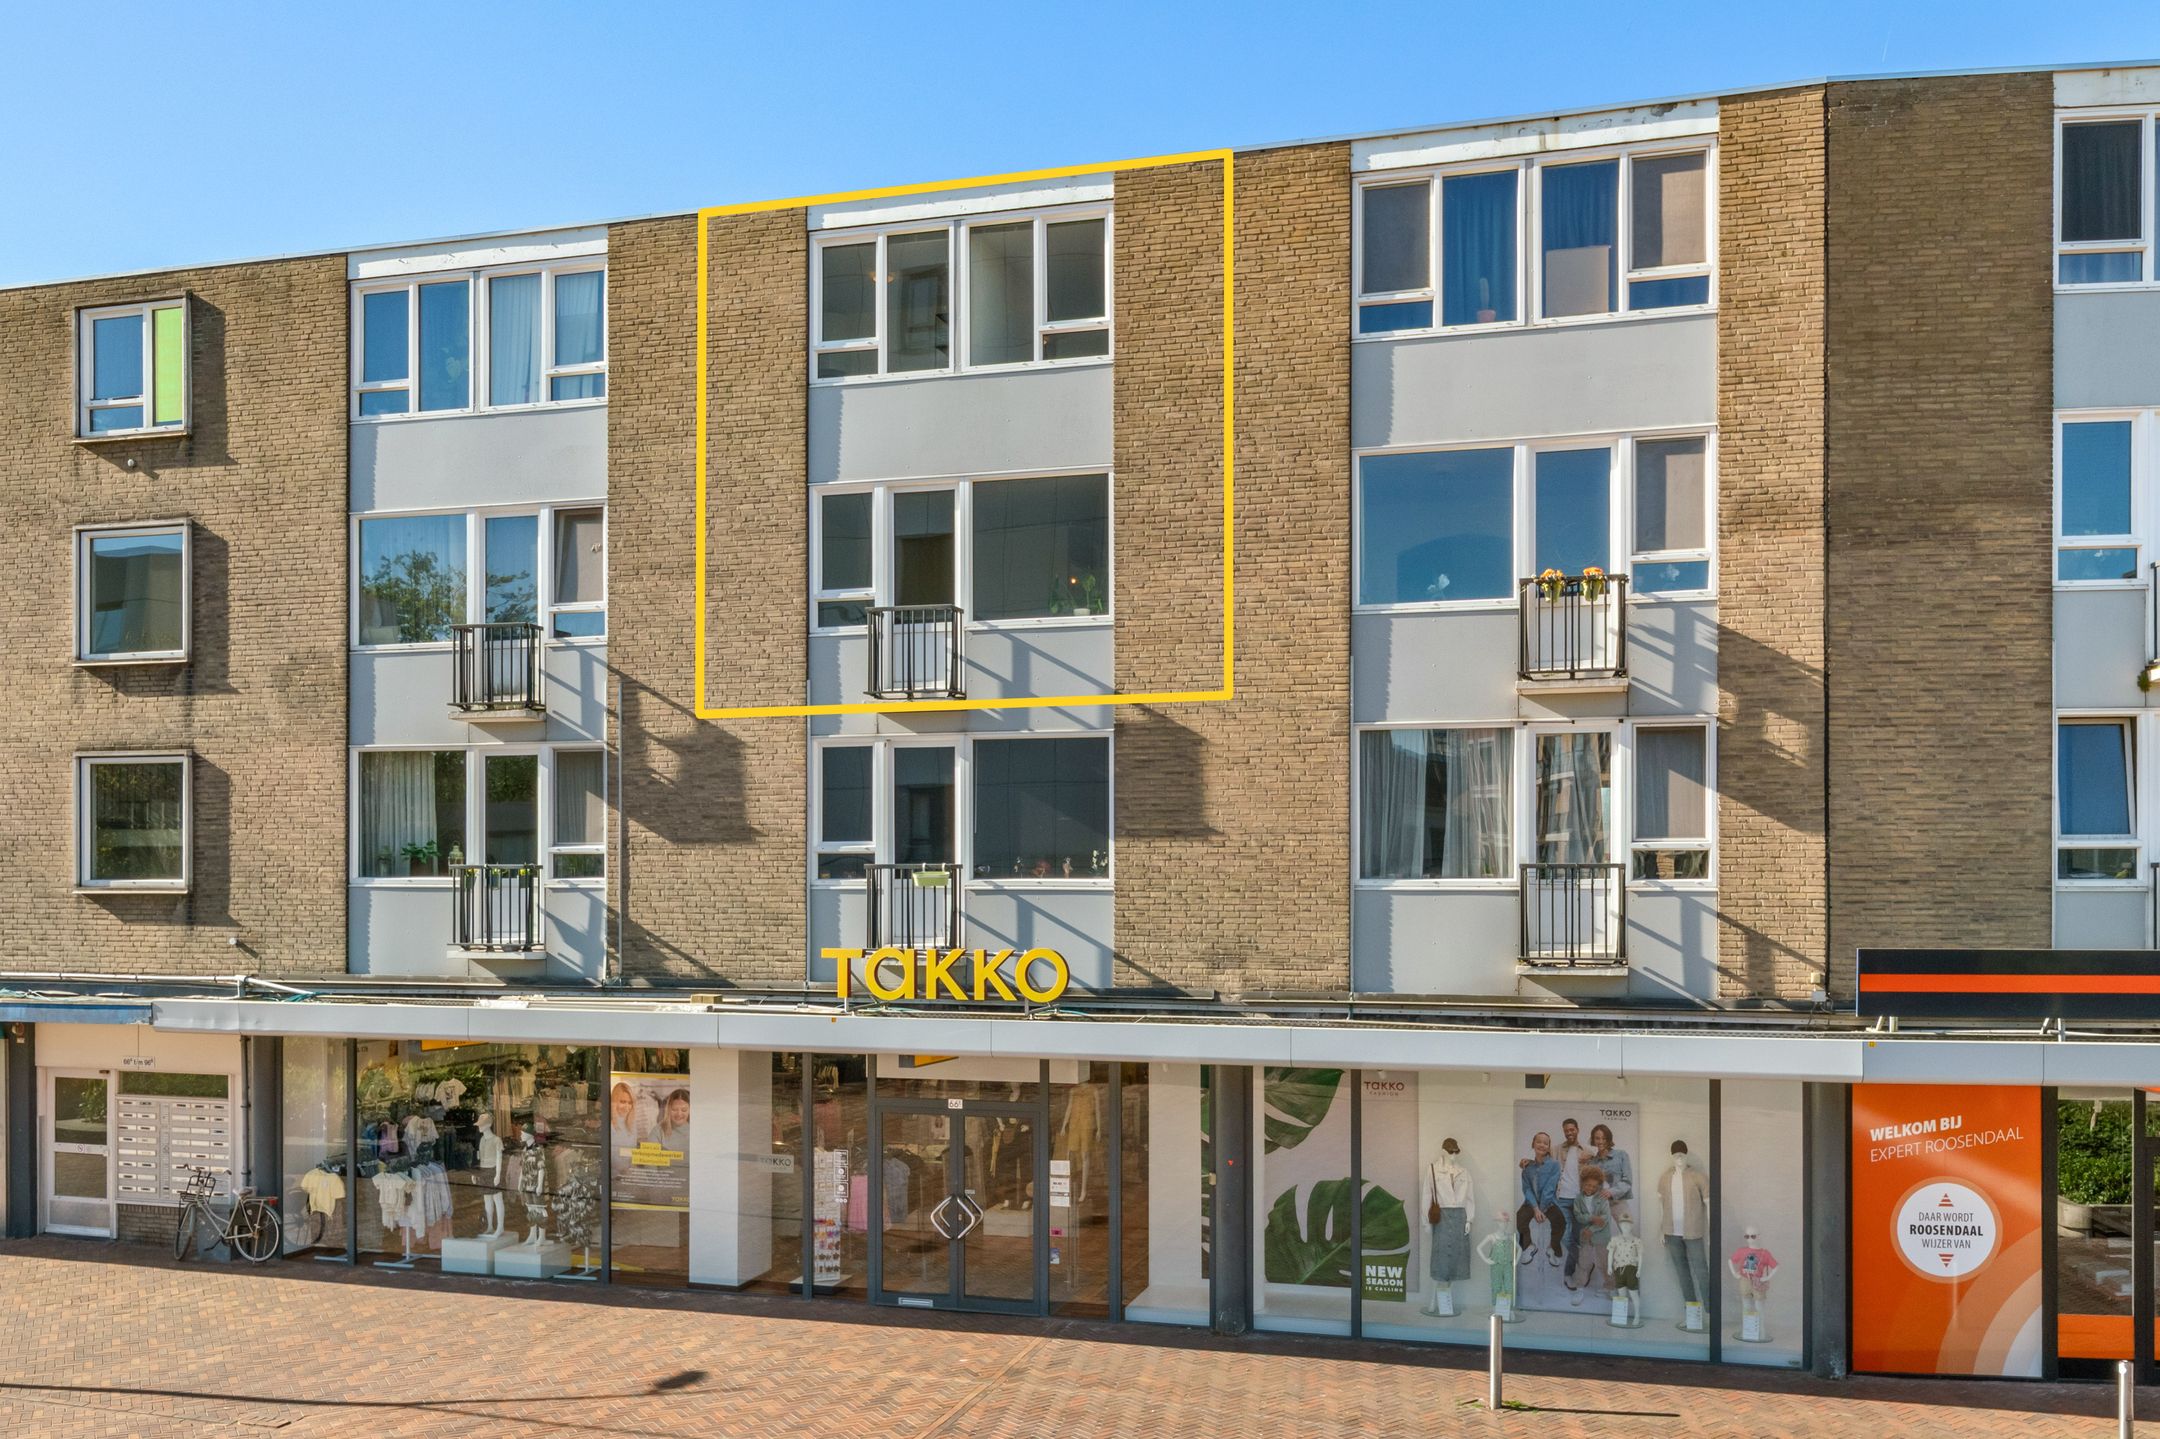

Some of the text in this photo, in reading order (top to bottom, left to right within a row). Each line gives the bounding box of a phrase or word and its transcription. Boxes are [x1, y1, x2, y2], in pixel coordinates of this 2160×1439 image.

[1870, 1115, 1962, 1142] WELKOM BIJ
[1870, 1126, 2024, 1162] EXPERT ROOSENDAAL
[1918, 1211, 1974, 1222] DAAR WORDT
[1909, 1224, 1983, 1236] ROOSENDAAL
[1921, 1238, 1971, 1248] WIJZER VAN
[1365, 1264, 1403, 1278] NEW
[1366, 1277, 1403, 1287] SEASON
